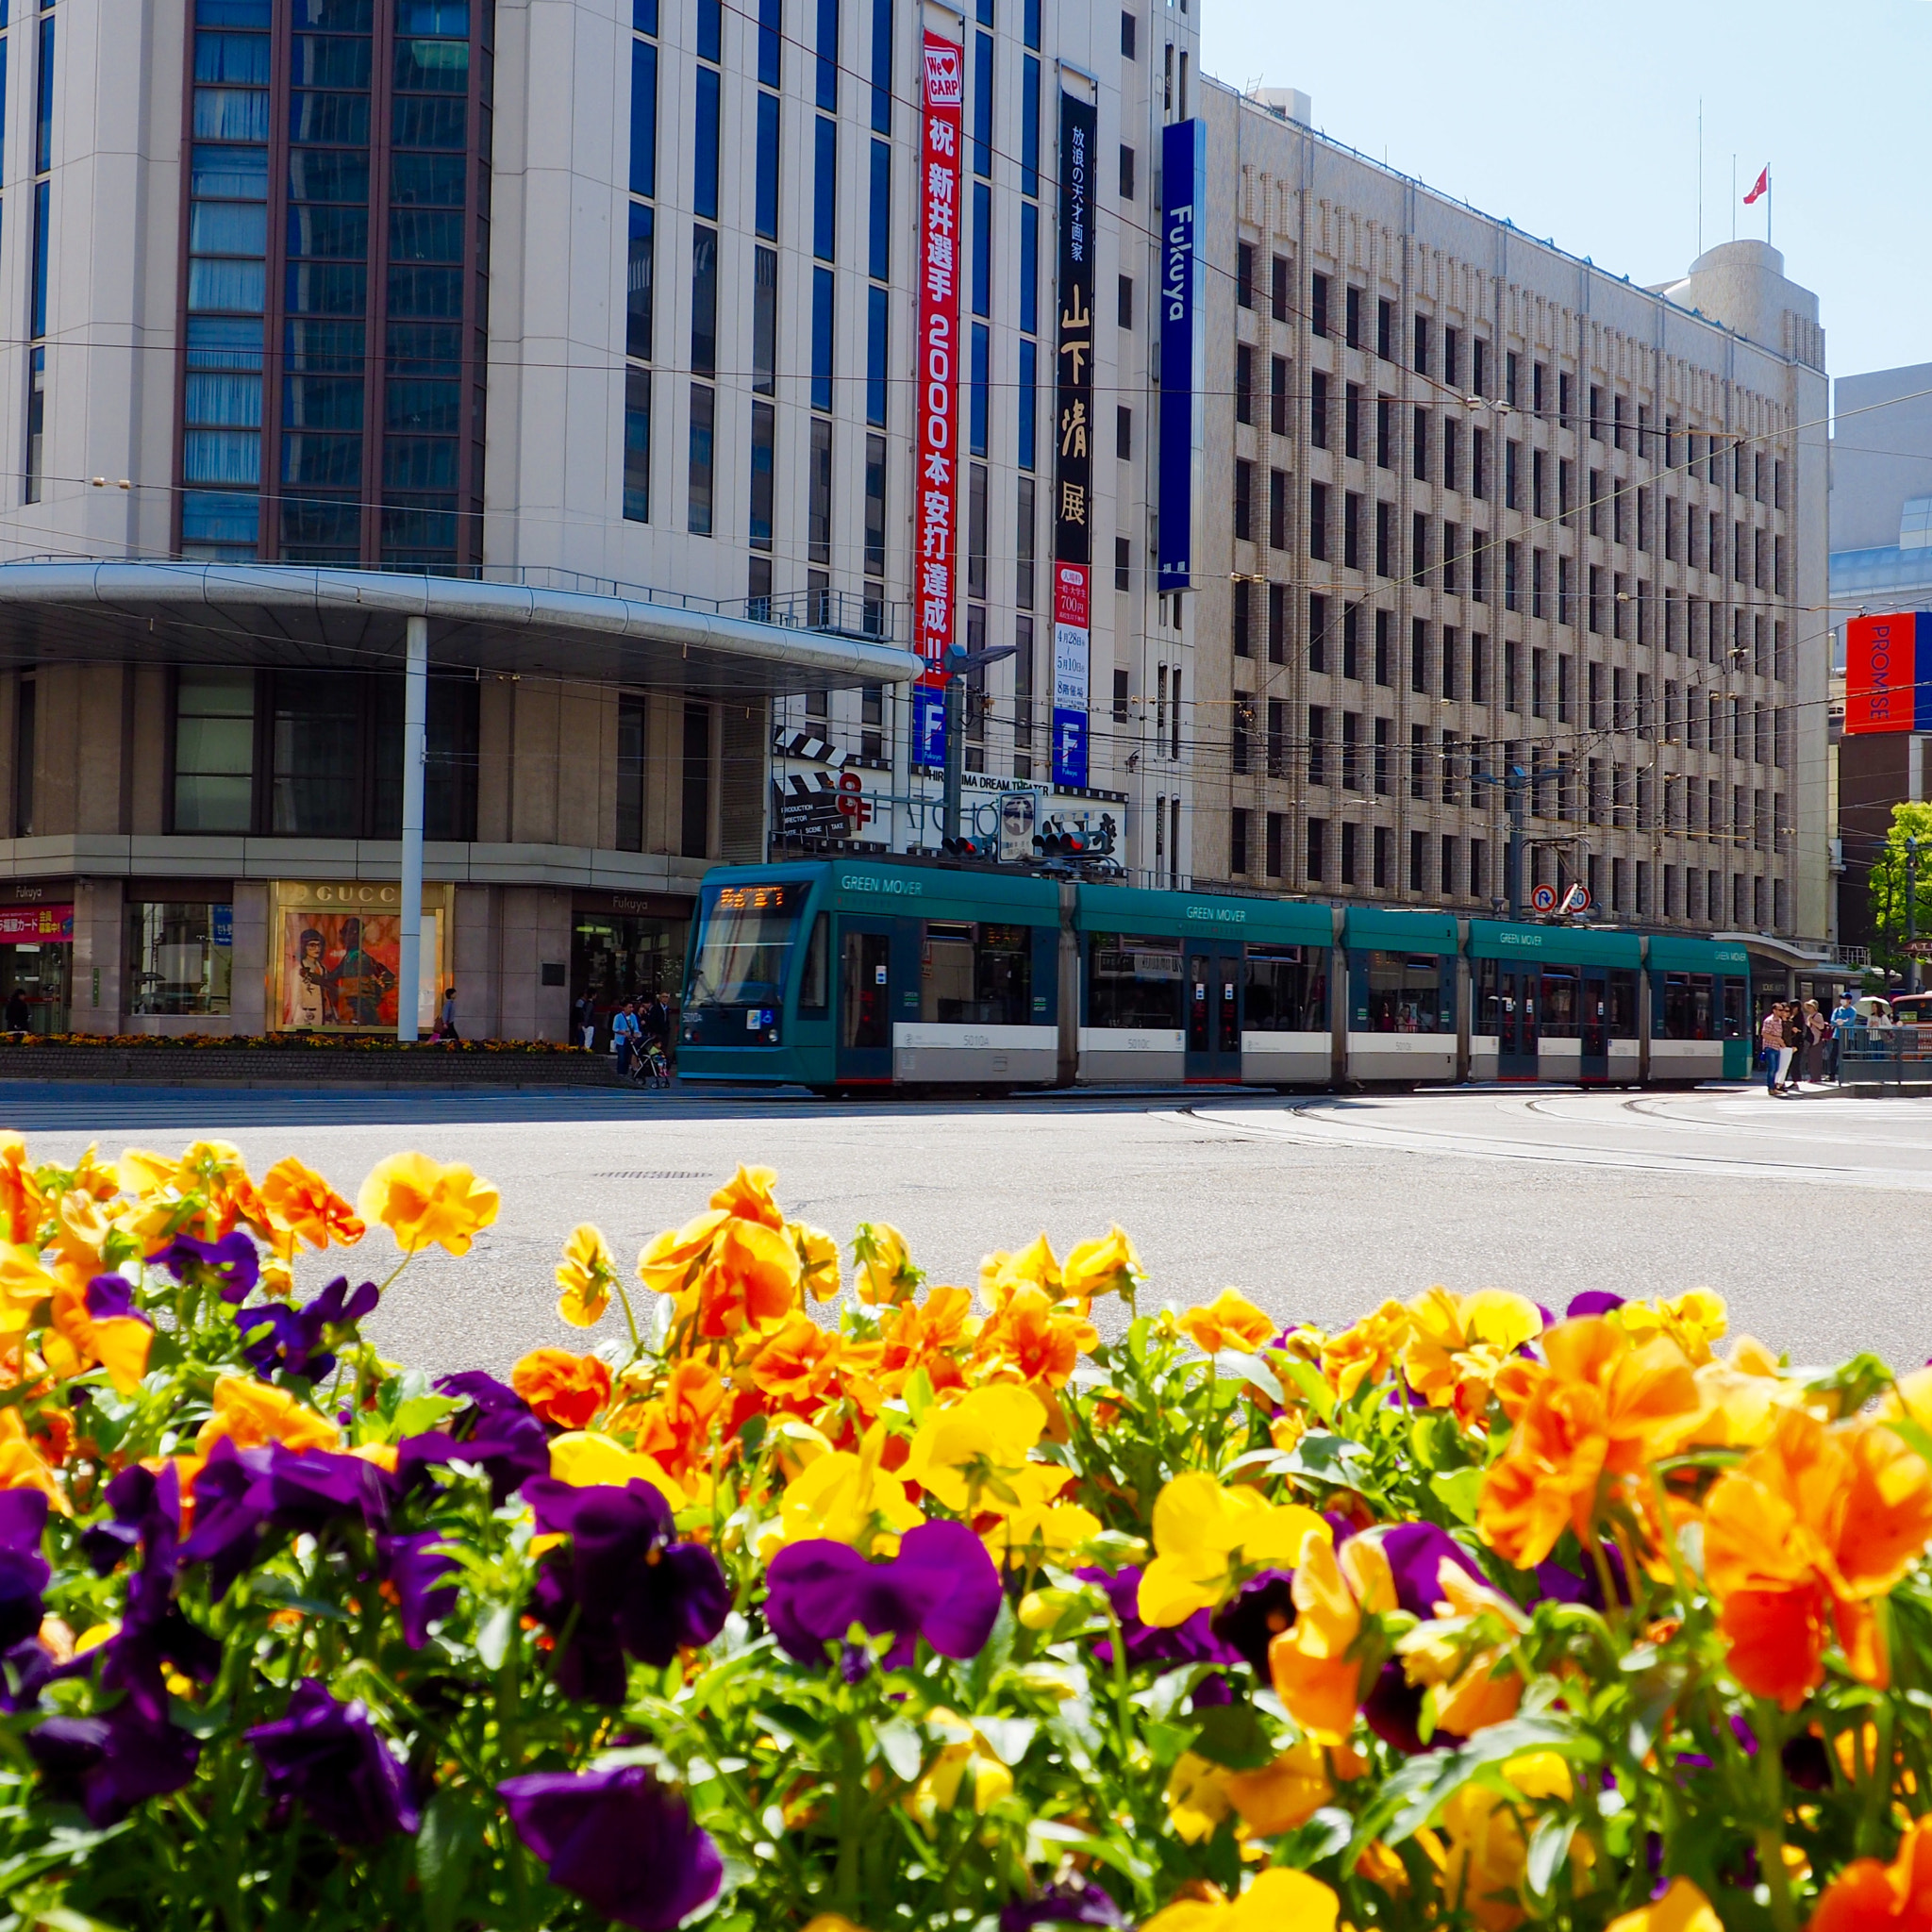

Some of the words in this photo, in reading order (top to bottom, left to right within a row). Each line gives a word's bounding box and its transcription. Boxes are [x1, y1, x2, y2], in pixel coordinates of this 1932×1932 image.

[930, 79, 959, 96] CARP
[1162, 204, 1192, 322] Fukuya
[1061, 595, 1084, 613] 700円
[928, 769, 977, 787] HIRIMA
[980, 776, 1009, 791] DREAM
[805, 825, 822, 834] SCENE
[841, 875, 879, 891] GREEN
[882, 879, 922, 895] MOVER
[316, 886, 395, 903] GUCC
[613, 896, 648, 913] Fukuya
[1187, 907, 1213, 920] GREEN
[1216, 908, 1246, 922] MOVER
[1500, 933, 1520, 944] GREEN
